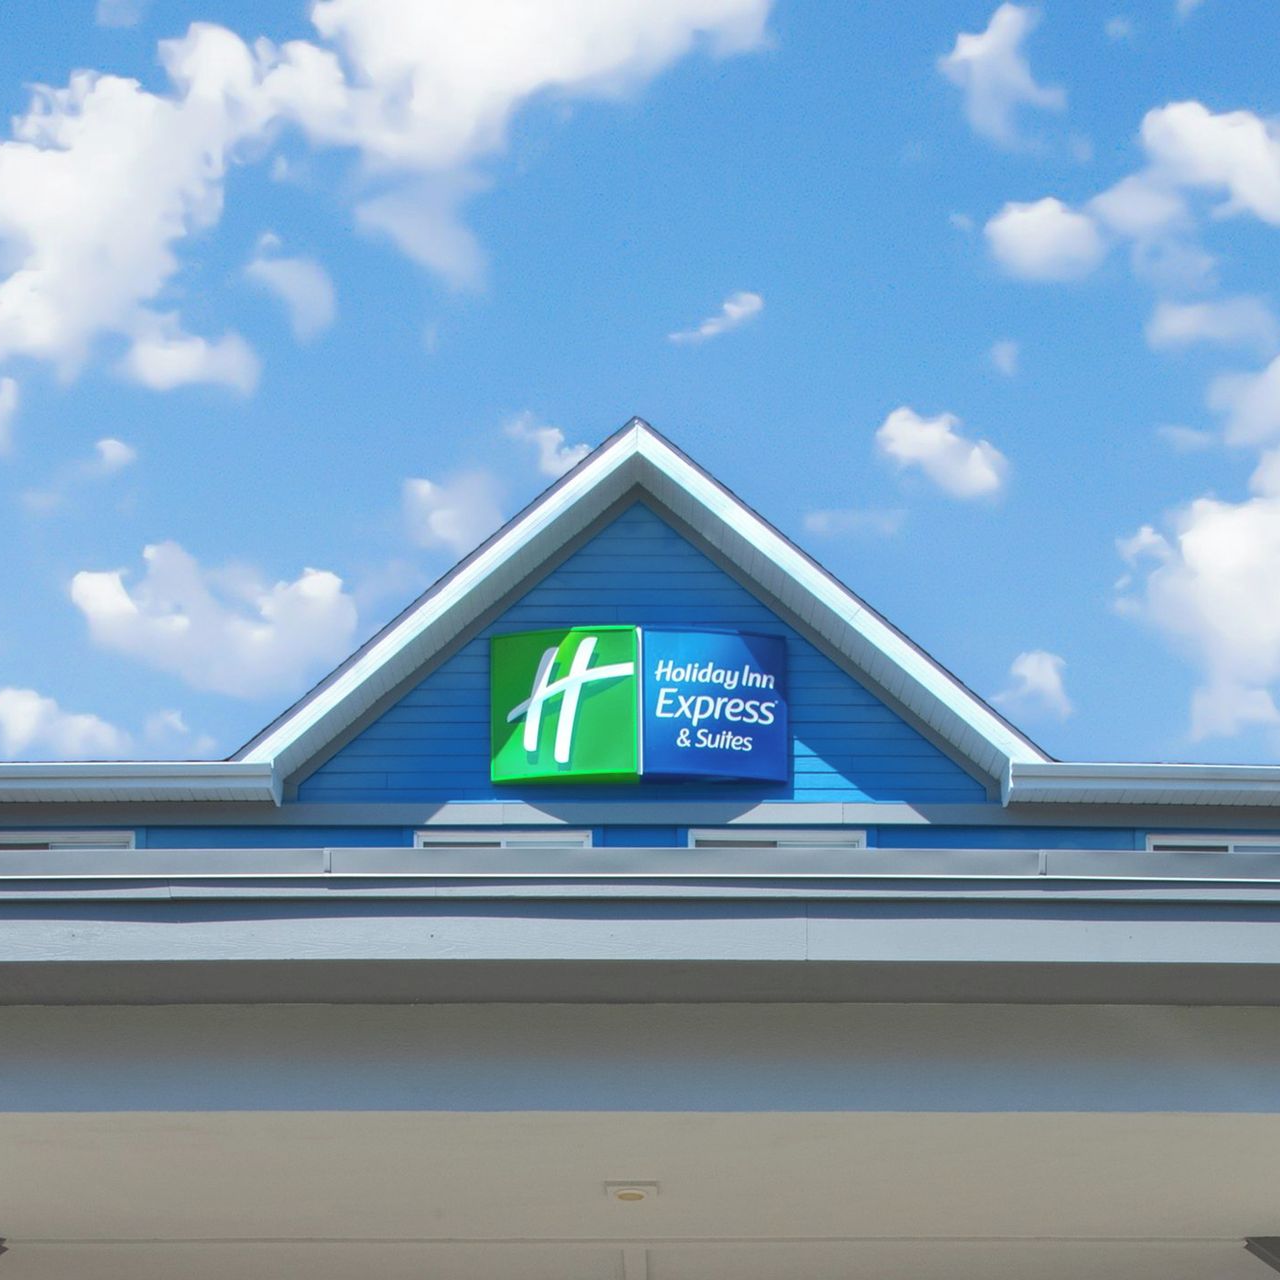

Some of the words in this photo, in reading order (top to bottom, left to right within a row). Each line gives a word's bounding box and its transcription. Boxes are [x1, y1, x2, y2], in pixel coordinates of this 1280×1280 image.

[654, 659, 740, 690] Holiday
[741, 664, 775, 690] Inn
[655, 687, 776, 727] Express
[676, 728, 691, 748] &
[695, 728, 753, 752] Suites
